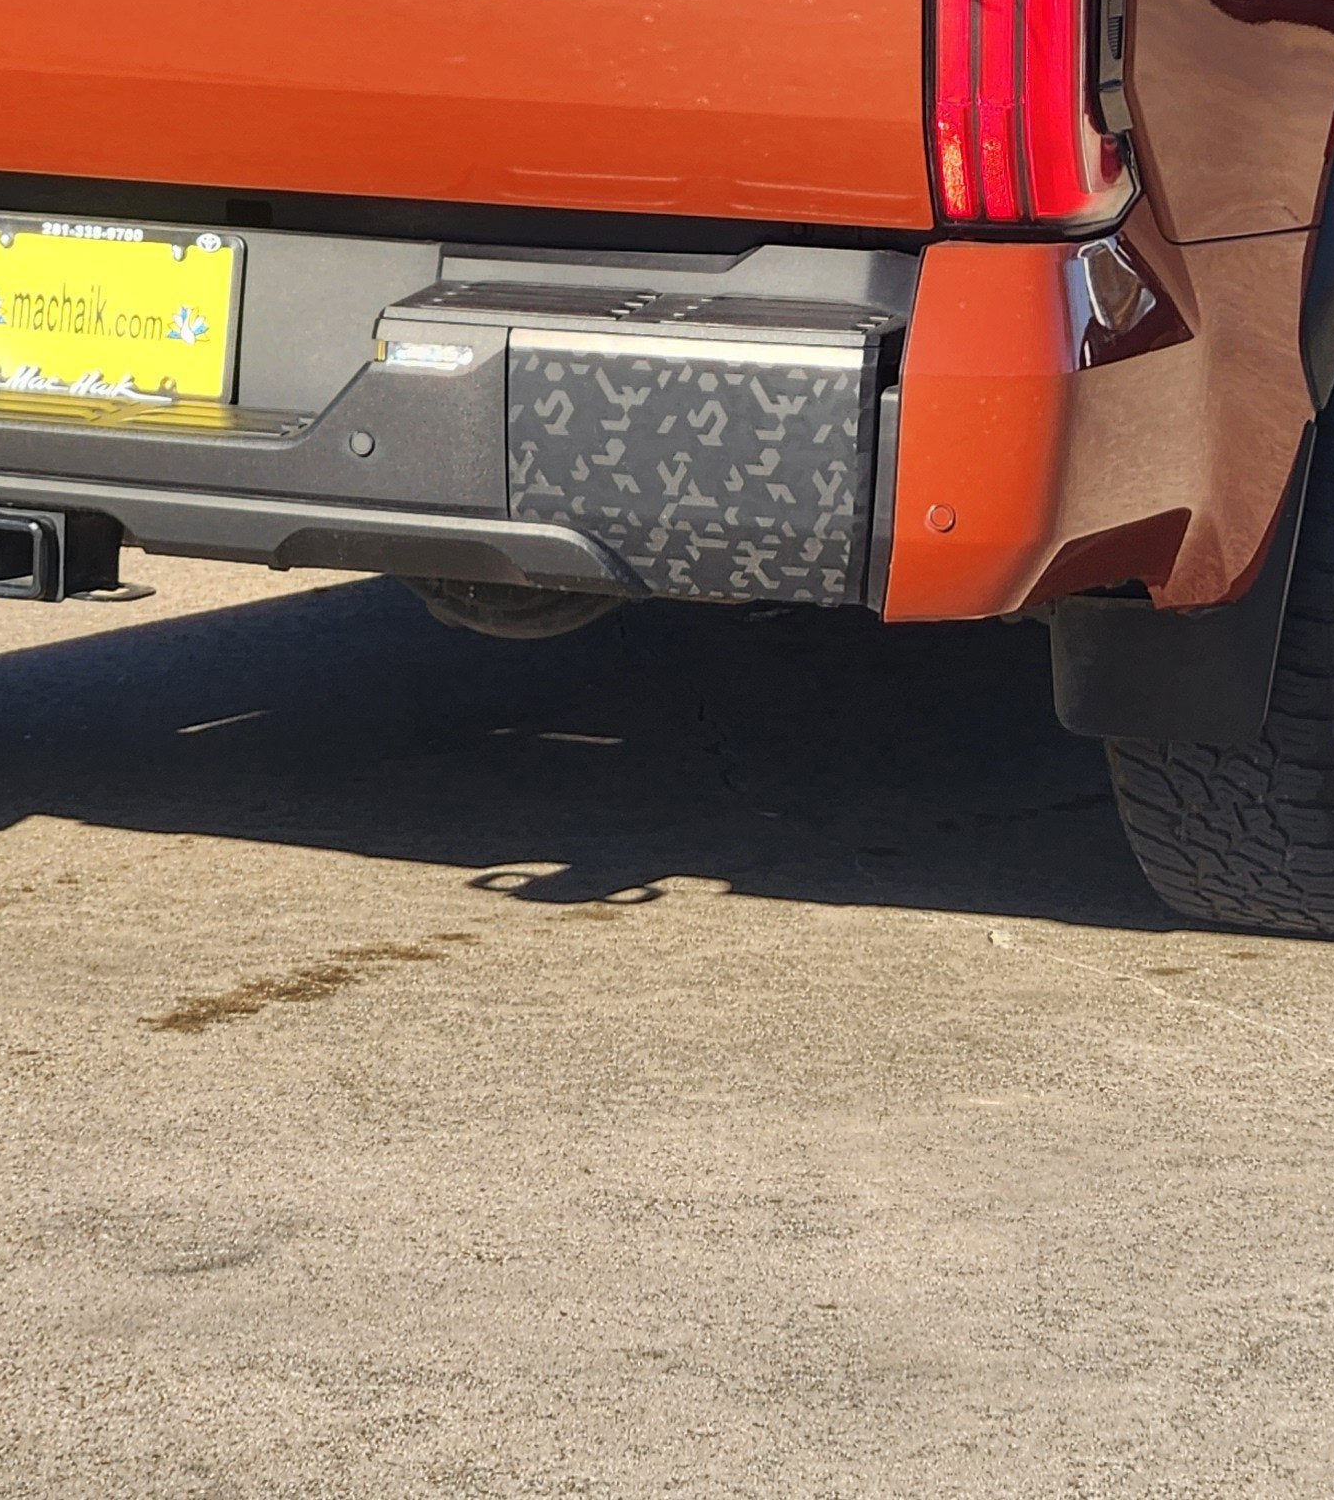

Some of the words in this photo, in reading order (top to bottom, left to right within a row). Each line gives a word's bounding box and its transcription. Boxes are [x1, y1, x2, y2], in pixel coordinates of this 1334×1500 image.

[10, 282, 164, 341] machaik.com
[3, 363, 68, 393] Mac
[68, 370, 172, 403] Haik
